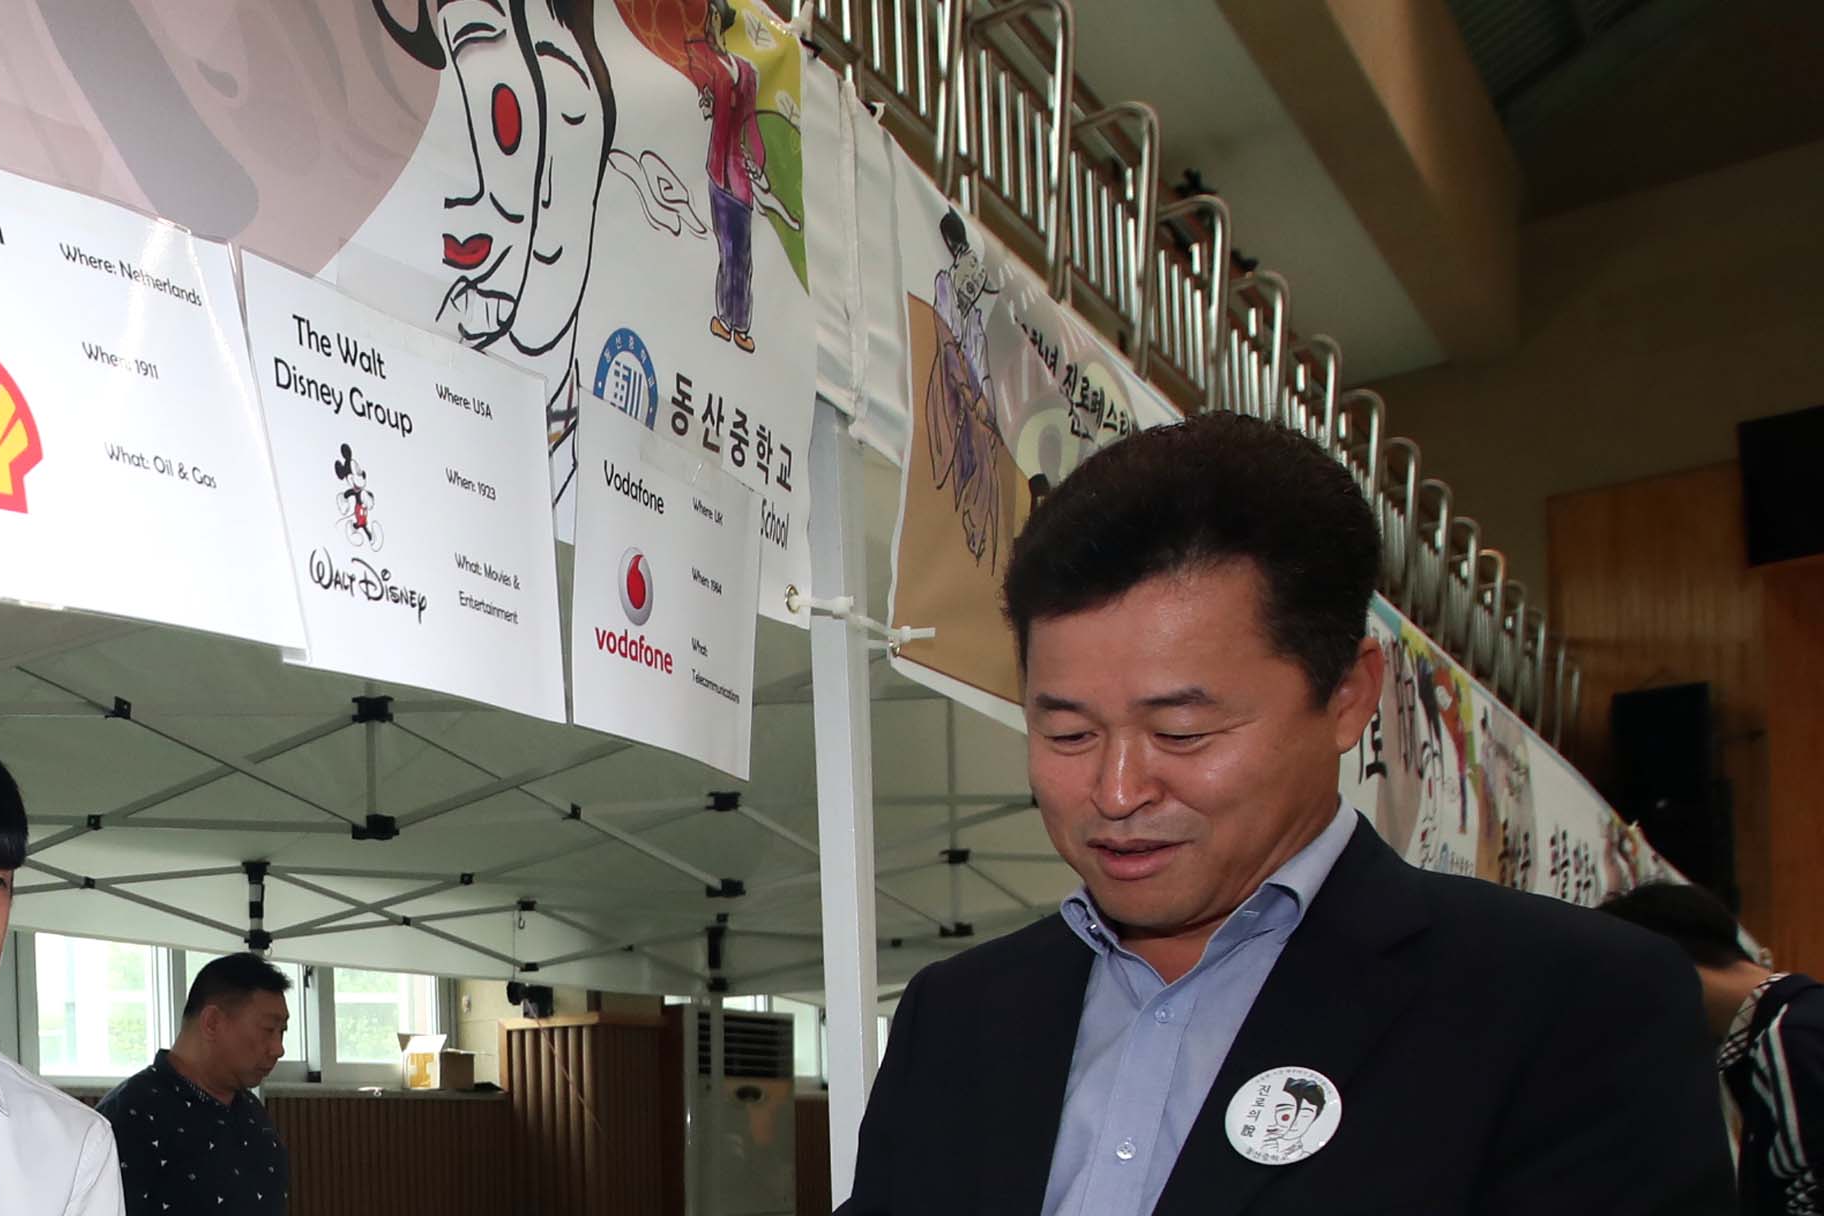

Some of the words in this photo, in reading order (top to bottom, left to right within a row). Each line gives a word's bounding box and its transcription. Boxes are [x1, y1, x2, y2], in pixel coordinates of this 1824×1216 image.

[59, 242, 118, 277] Where:
[134, 358, 160, 380] 1911
[291, 313, 332, 359] The
[336, 331, 387, 381] Walt
[272, 356, 345, 415] Disney
[348, 392, 414, 438] Group
[435, 382, 471, 411] Where:
[472, 394, 493, 421] USA
[670, 371, 793, 493] 동산중학교
[104, 440, 151, 471] What:
[152, 454, 175, 477] Oil
[177, 462, 190, 482] &
[192, 462, 218, 490] Gas
[445, 466, 475, 494] When:
[476, 480, 497, 502] 1923
[603, 459, 665, 515] Vodafone
[714, 508, 724, 526] UK
[760, 497, 790, 551] School
[454, 551, 482, 579] What:
[483, 561, 510, 589] Movies
[513, 576, 521, 591] &
[458, 589, 519, 625] Entertainment
[594, 626, 674, 675] vodafone
